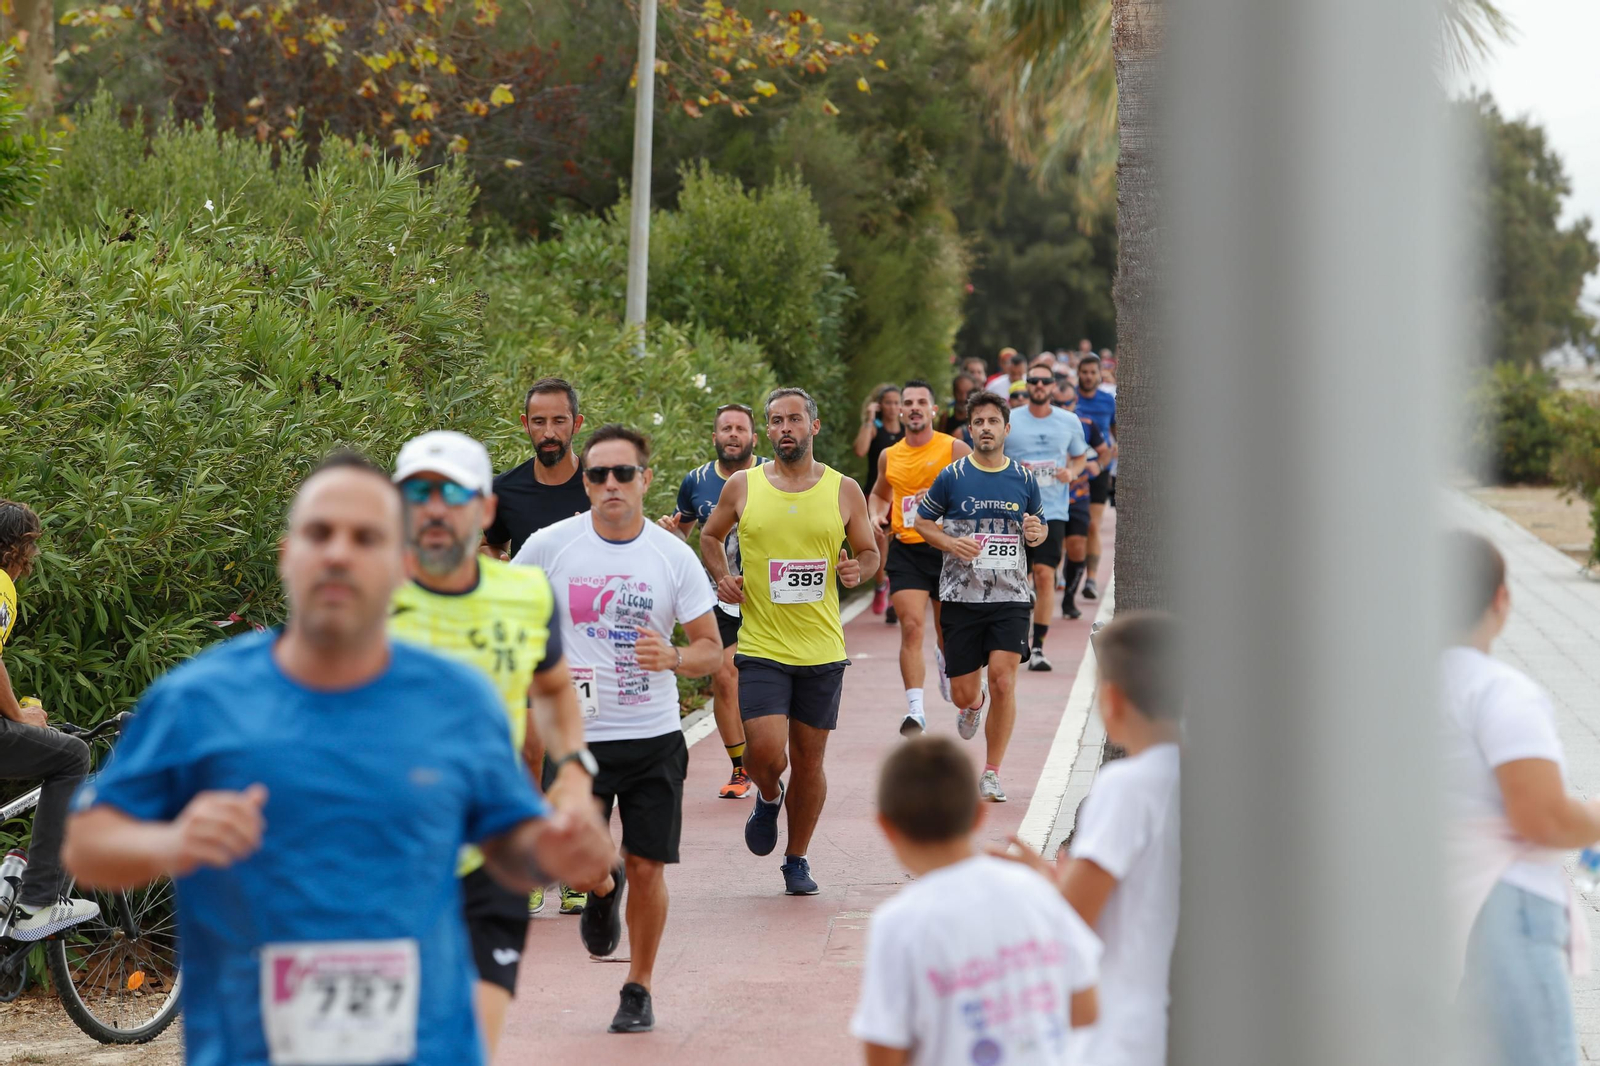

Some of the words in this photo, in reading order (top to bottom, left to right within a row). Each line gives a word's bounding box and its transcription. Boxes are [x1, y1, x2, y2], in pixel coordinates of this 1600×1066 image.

[988, 545, 1017, 556] 283
[788, 572, 824, 587] 393
[313, 975, 404, 1018] 727
